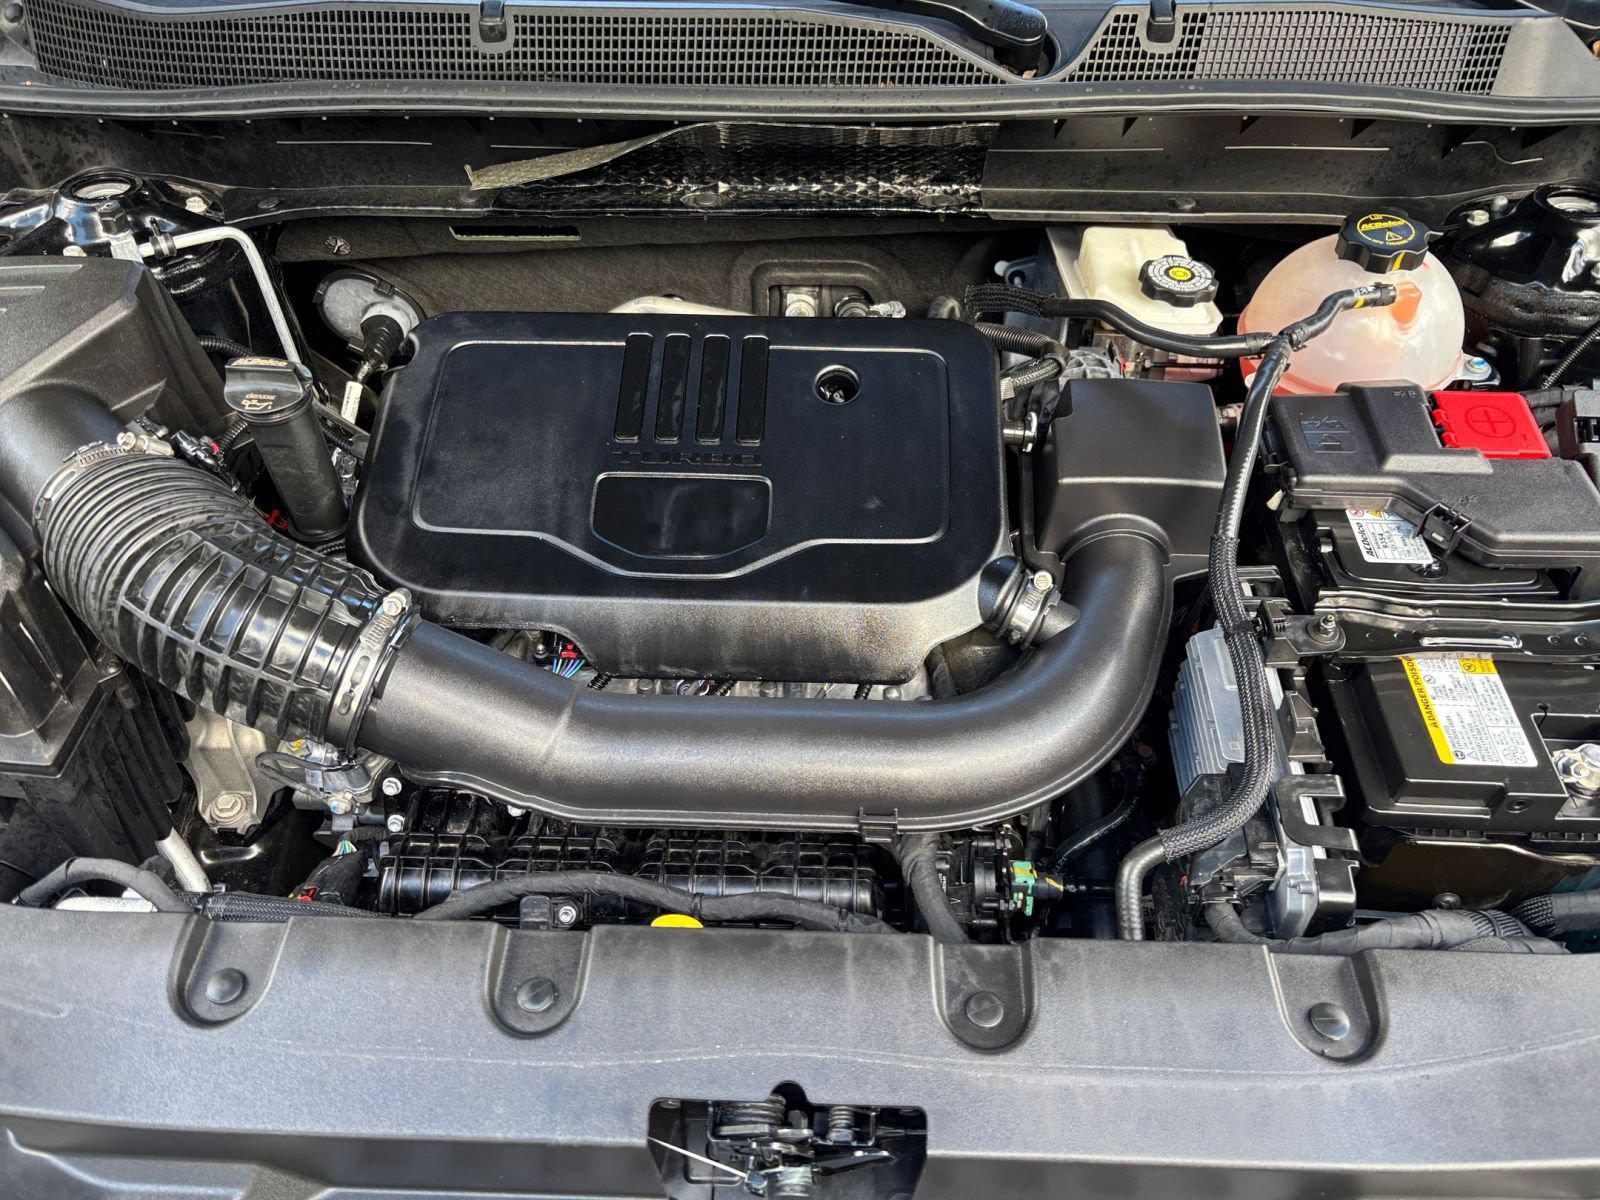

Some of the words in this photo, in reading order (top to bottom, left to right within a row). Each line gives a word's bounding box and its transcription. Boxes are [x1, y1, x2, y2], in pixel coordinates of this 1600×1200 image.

[1361, 219, 1406, 230] ACDelco
[612, 451, 762, 467] TURBO
[1356, 522, 1375, 557] ACDelco
